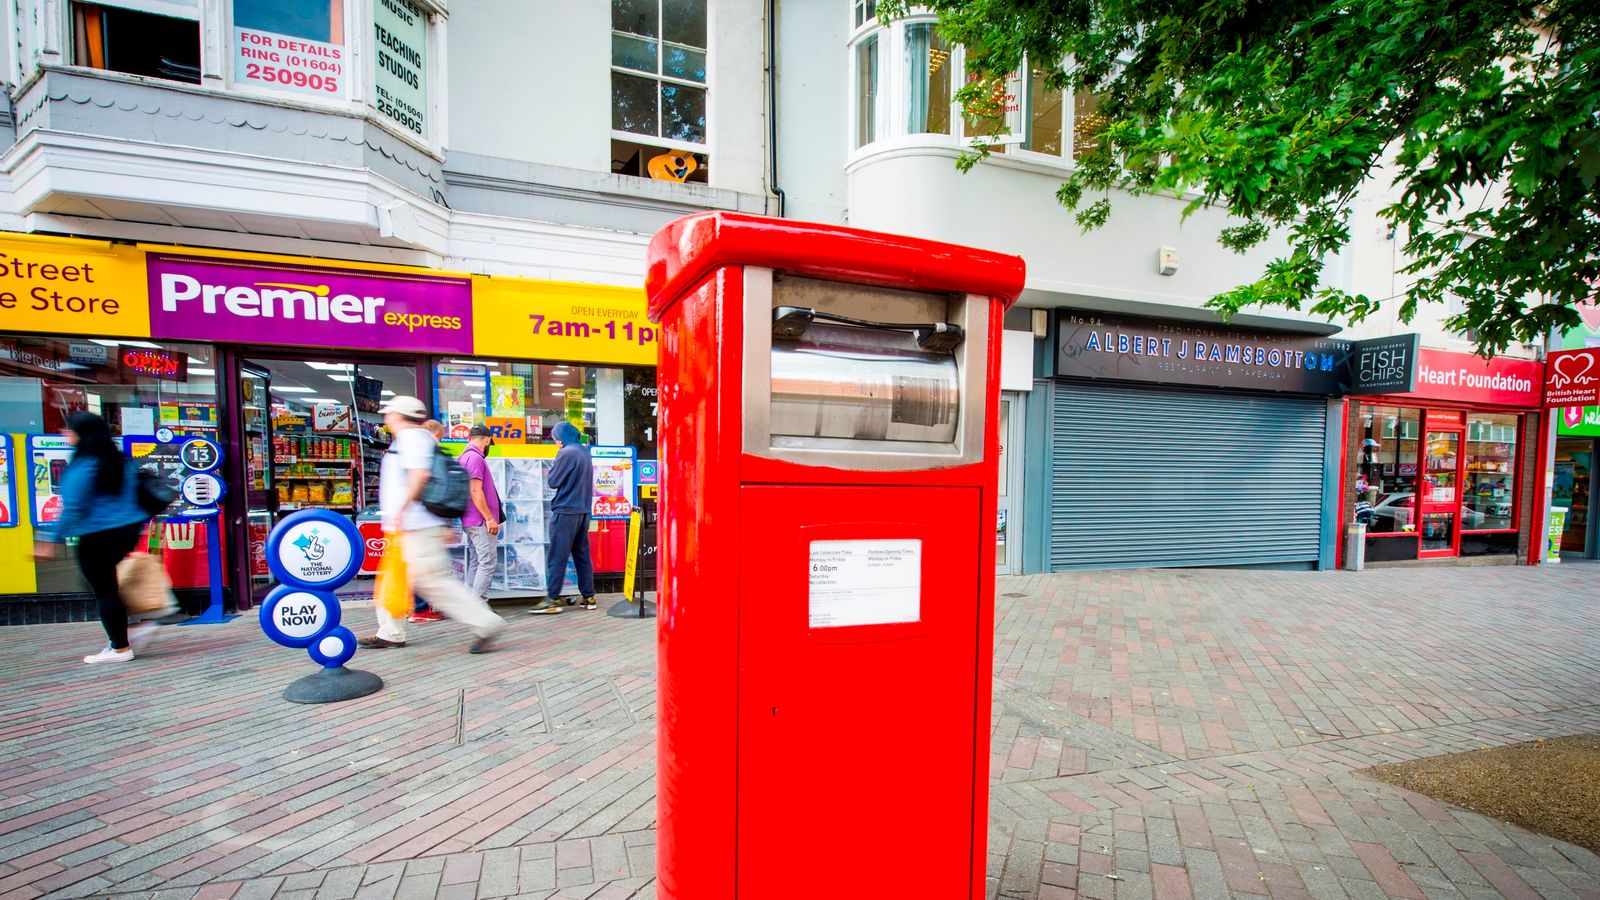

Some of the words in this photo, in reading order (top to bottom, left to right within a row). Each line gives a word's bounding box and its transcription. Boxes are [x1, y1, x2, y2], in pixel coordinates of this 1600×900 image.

[381, 0, 414, 26] MUSIC
[241, 32, 272, 47] FOR
[278, 39, 341, 59] DETAILS
[374, 22, 422, 70] TEACHING
[241, 47, 280, 62] RING
[286, 55, 342, 75] (01604)
[378, 50, 419, 90] STUDIOS
[246, 63, 338, 92] 250905
[375, 84, 393, 102] TEL:
[395, 97, 424, 122] (01604)
[377, 98, 422, 135] 250905
[30, 287, 120, 315] Store
[160, 272, 386, 325] Premier
[383, 312, 462, 332] express
[571, 306, 595, 317] OPEN
[596, 308, 639, 319] EVERYDAY
[1086, 331, 1172, 357] ALBERT
[1177, 340, 1188, 359] J
[1194, 340, 1334, 372] RAMSBOTTOM
[1332, 342, 1351, 351] 1982
[123, 353, 180, 373] OPEN
[1360, 349, 1405, 370] FISH
[443, 366, 479, 374] Lycamobile
[1158, 362, 1220, 375] RESTAURANT
[1240, 369, 1287, 379] TAKEAWAY
[1360, 366, 1404, 382] CHIPS
[1418, 364, 1456, 386] Heart
[1459, 368, 1531, 393] Foundation
[1546, 389, 1572, 397] British
[1572, 388, 1596, 396] Heart
[1546, 394, 1596, 403] Foundation
[318, 410, 342, 418] bueno
[489, 421, 522, 439] Ria
[595, 502, 631, 515] £3.25
[813, 563, 838, 572] 6.00pm
[281, 604, 317, 617] PLAY
[282, 614, 318, 627] NOW
